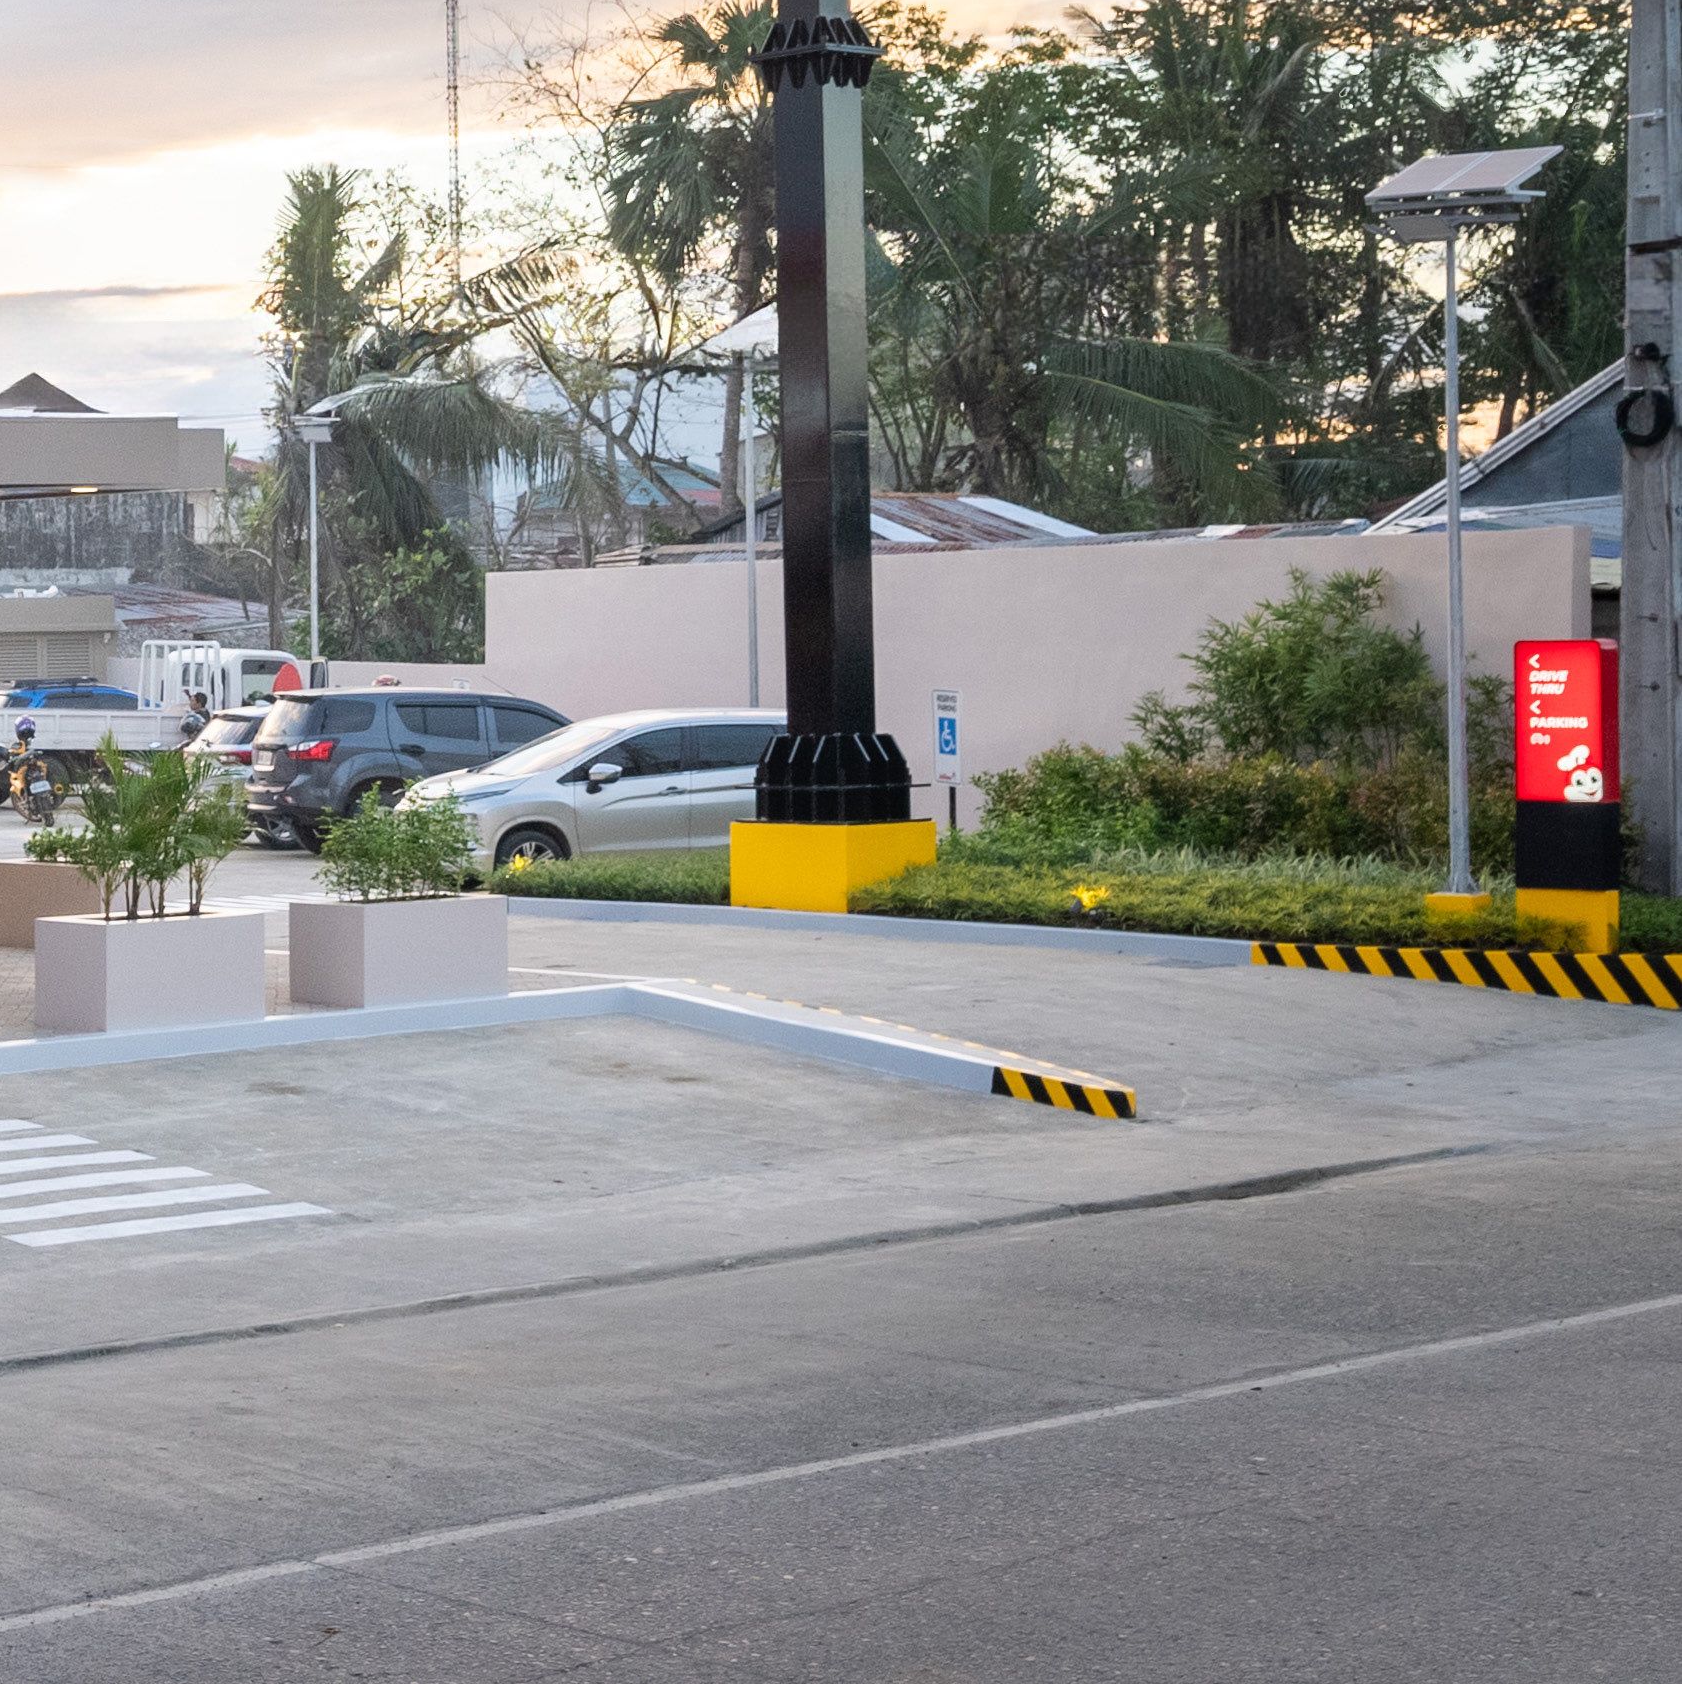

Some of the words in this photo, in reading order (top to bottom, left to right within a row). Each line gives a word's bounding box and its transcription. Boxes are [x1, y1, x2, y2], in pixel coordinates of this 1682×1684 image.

[1529, 670, 1568, 682] DRIVE
[1530, 683, 1565, 695] THRU
[1529, 717, 1589, 729] PARKING
